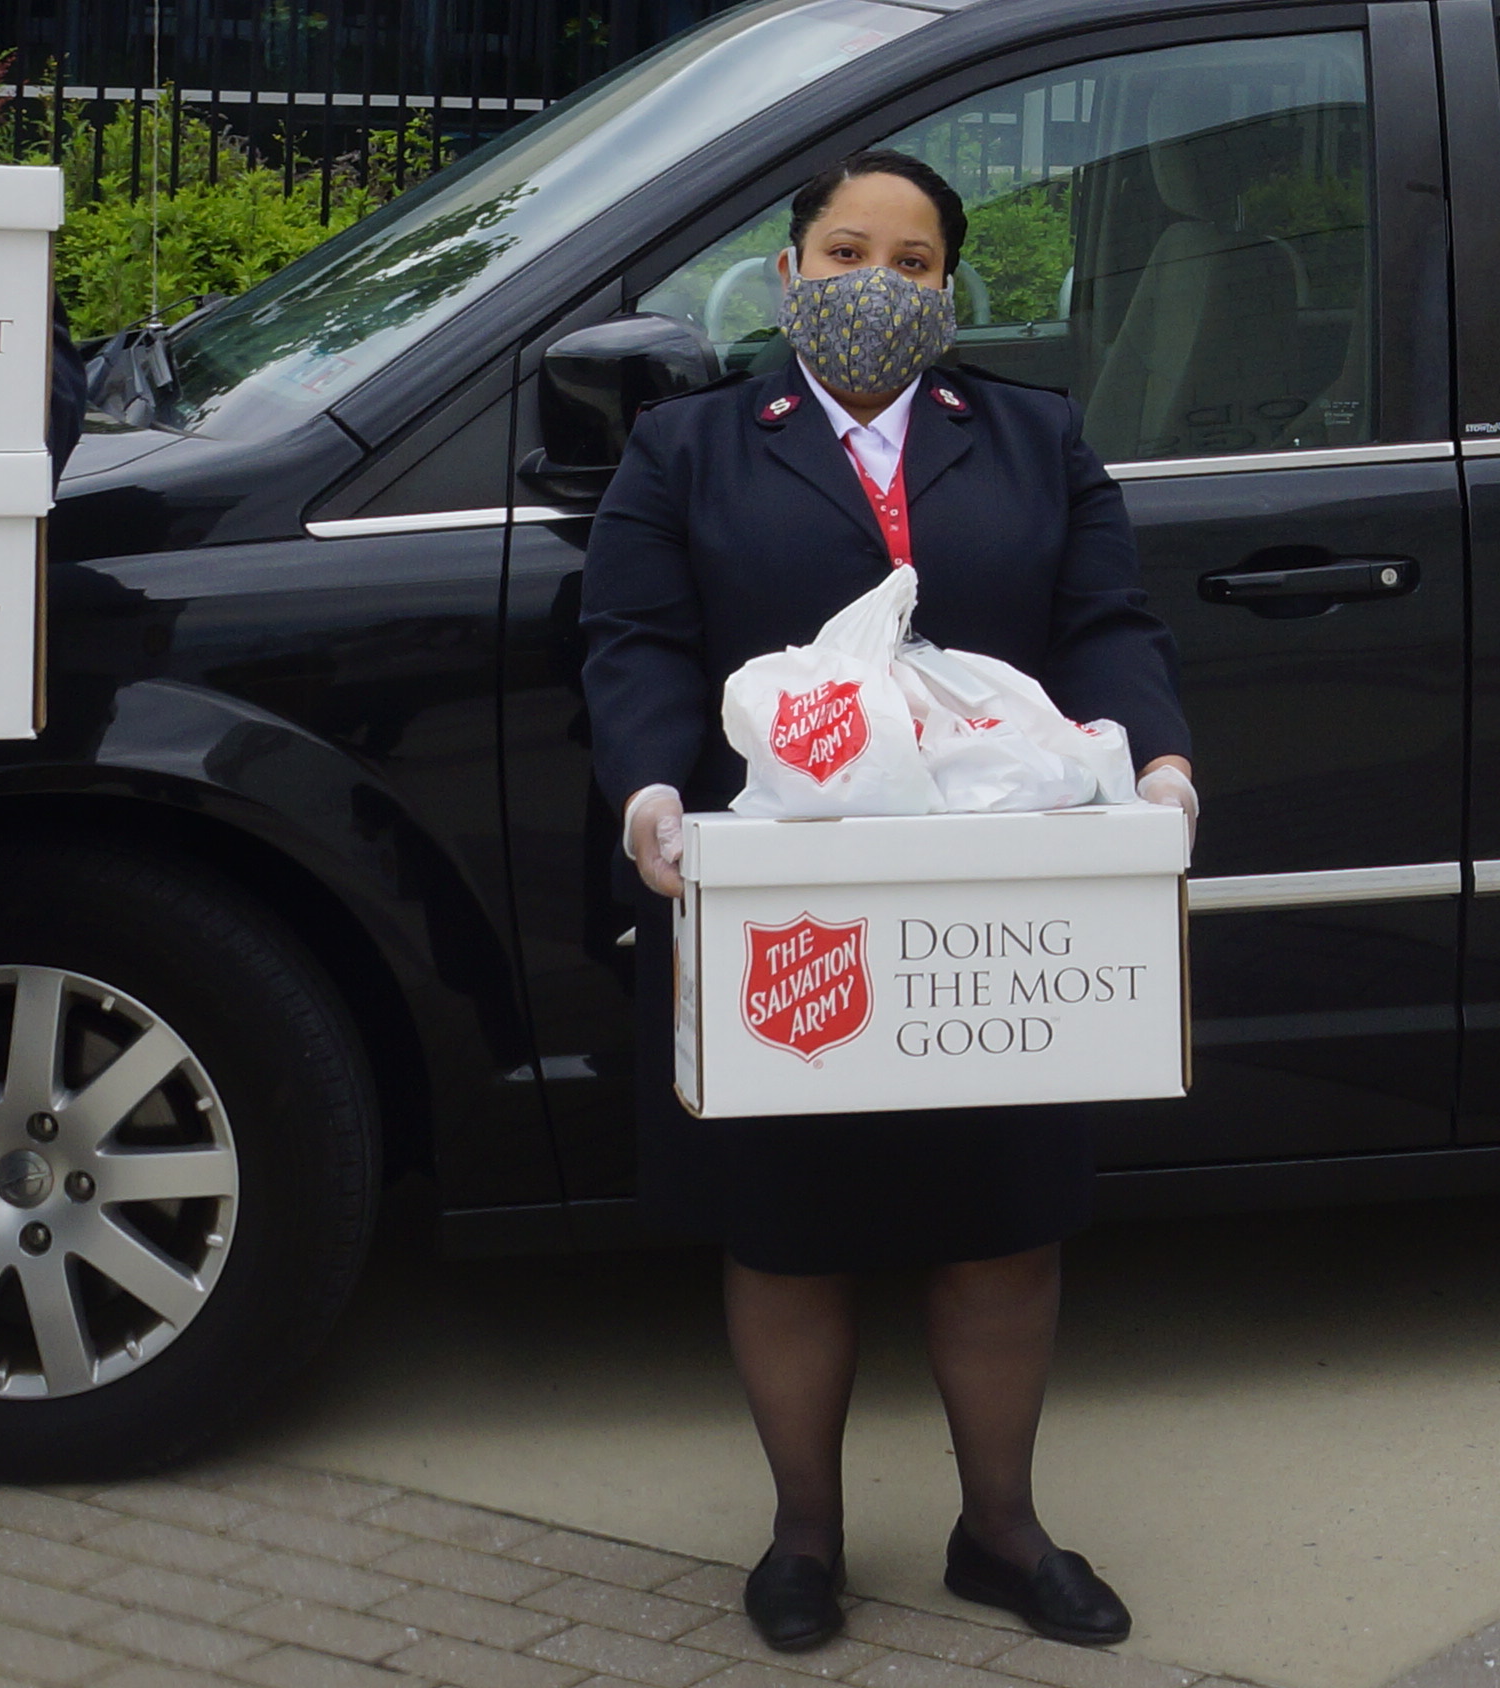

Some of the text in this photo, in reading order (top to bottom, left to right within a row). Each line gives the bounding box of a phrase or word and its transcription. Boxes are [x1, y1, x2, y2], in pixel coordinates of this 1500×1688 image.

[789, 682, 831, 717] THE
[807, 714, 853, 768] ARMY
[765, 929, 816, 978] THE
[898, 918, 1073, 963] DOING
[750, 939, 859, 1024] SALVATION
[894, 965, 1147, 1008] THE MOST
[788, 982, 856, 1046] ARMY
[896, 1017, 1054, 1057] GOOD
